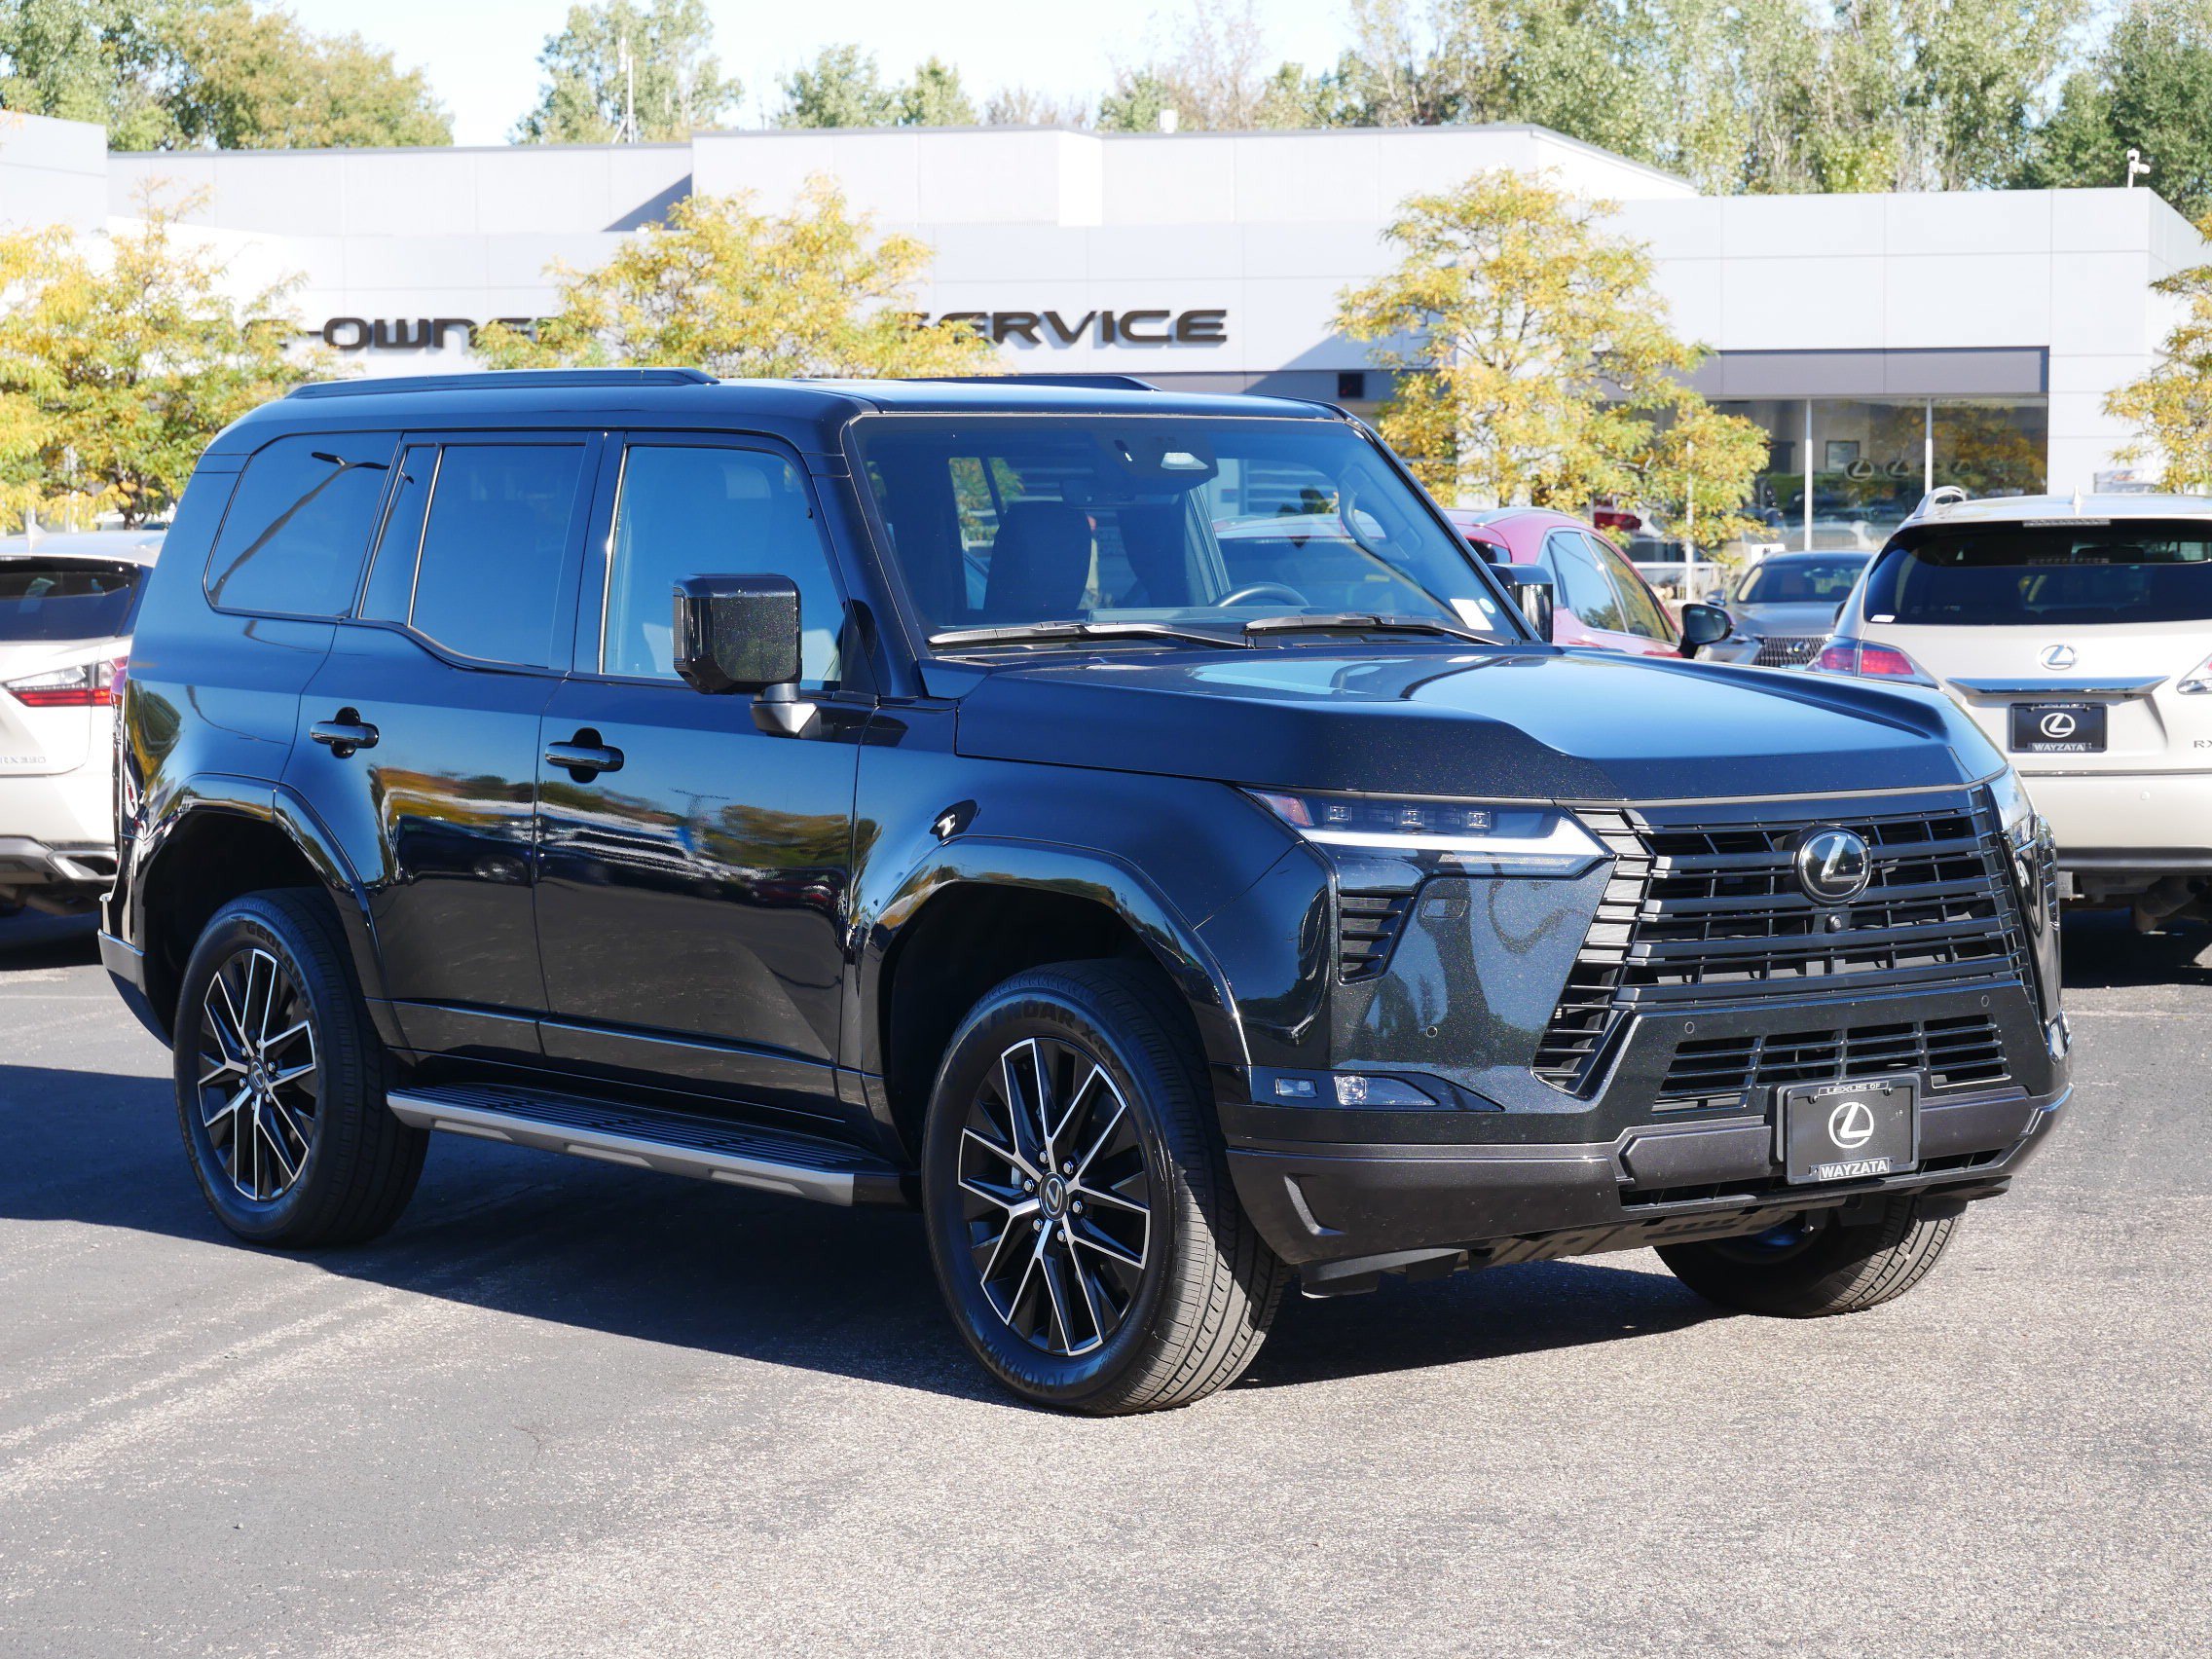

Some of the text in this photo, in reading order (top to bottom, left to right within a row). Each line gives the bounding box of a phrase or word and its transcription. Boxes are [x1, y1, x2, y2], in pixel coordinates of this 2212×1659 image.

[2033, 743, 2084, 752] WAYZATA
[1826, 1084, 1867, 1094] LEXUS
[1821, 1160, 1888, 1180] WAYZATA
